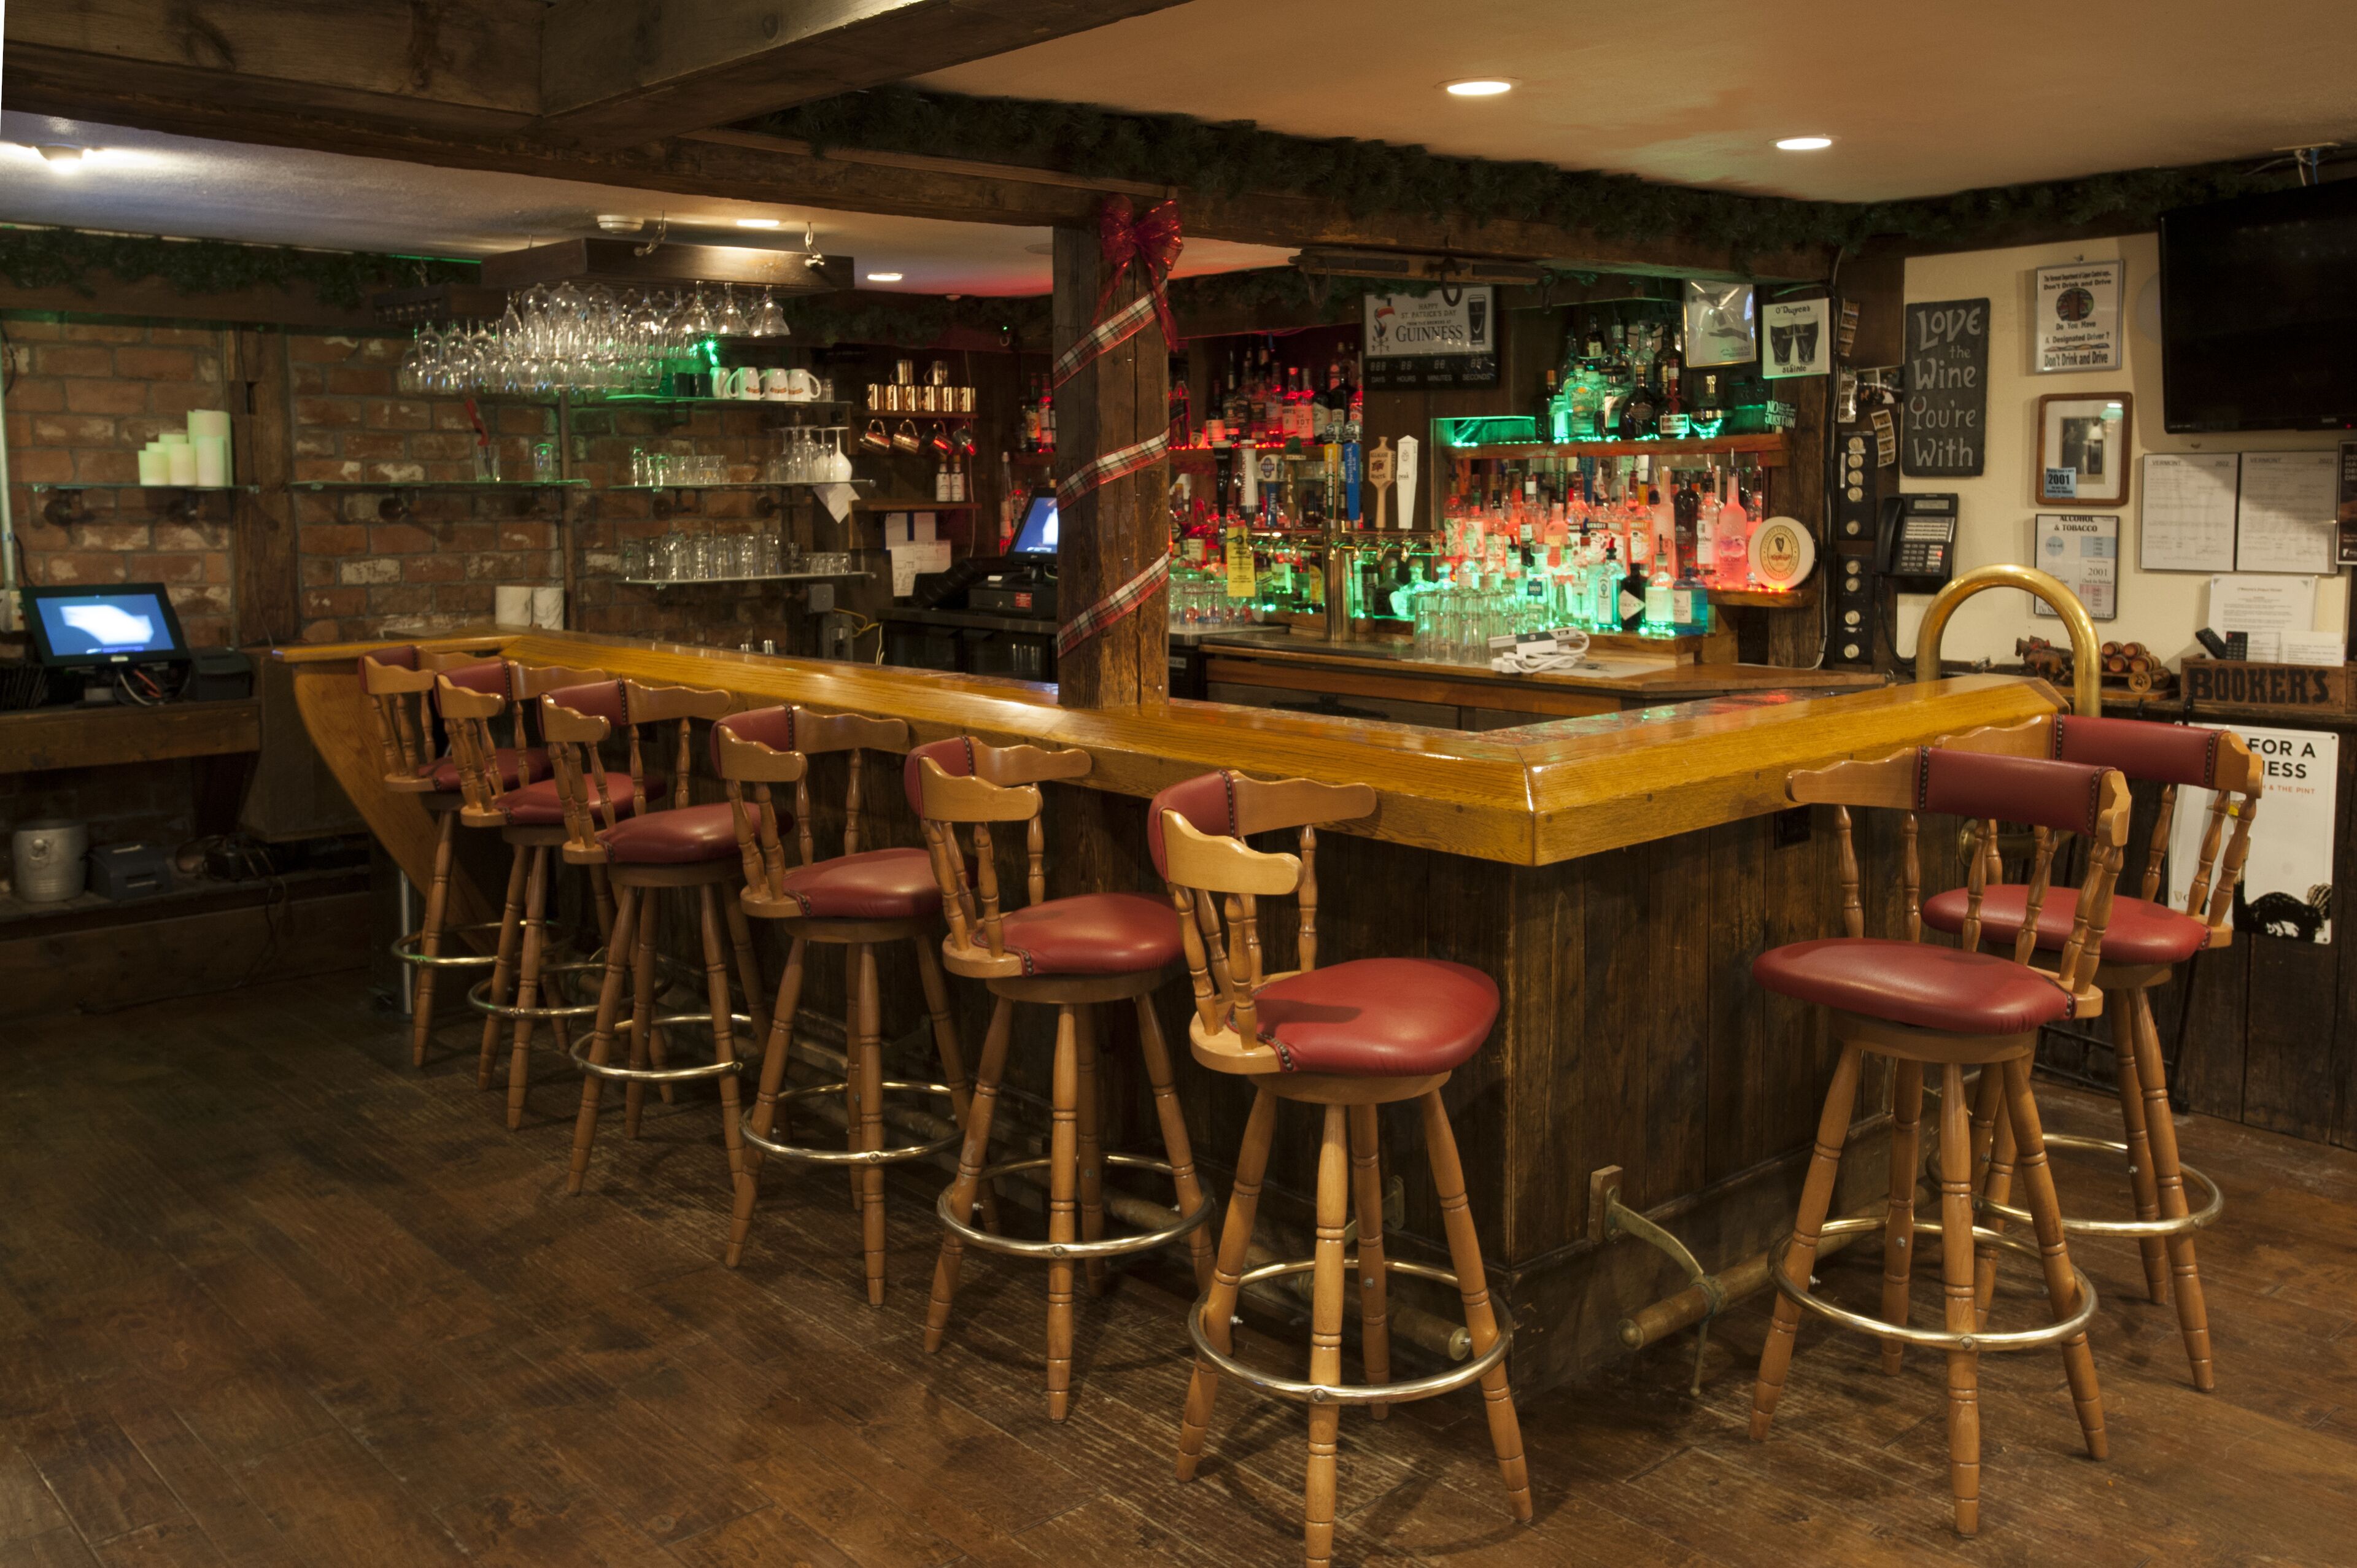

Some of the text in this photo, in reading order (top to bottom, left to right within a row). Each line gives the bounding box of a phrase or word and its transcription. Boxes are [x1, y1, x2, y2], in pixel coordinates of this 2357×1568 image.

[1396, 325, 1463, 342] GUINNESS
[1916, 307, 1981, 351] LOVE
[2053, 334, 2086, 344] Designated
[2087, 332, 2105, 341] Driver
[1949, 345, 1971, 358] the
[2045, 350, 2108, 366] Don't Drink and Drive
[1913, 357, 1976, 390] Wine
[1766, 400, 1779, 414] NO
[1910, 396, 1976, 430] You're
[1913, 438, 1973, 467] With
[2048, 473, 2070, 485] 2001
[2088, 568, 2107, 576] 2001
[2187, 667, 2329, 704] BOOKER'S
[2248, 738, 2316, 758] FOR A
[2262, 760, 2307, 779] ESS
